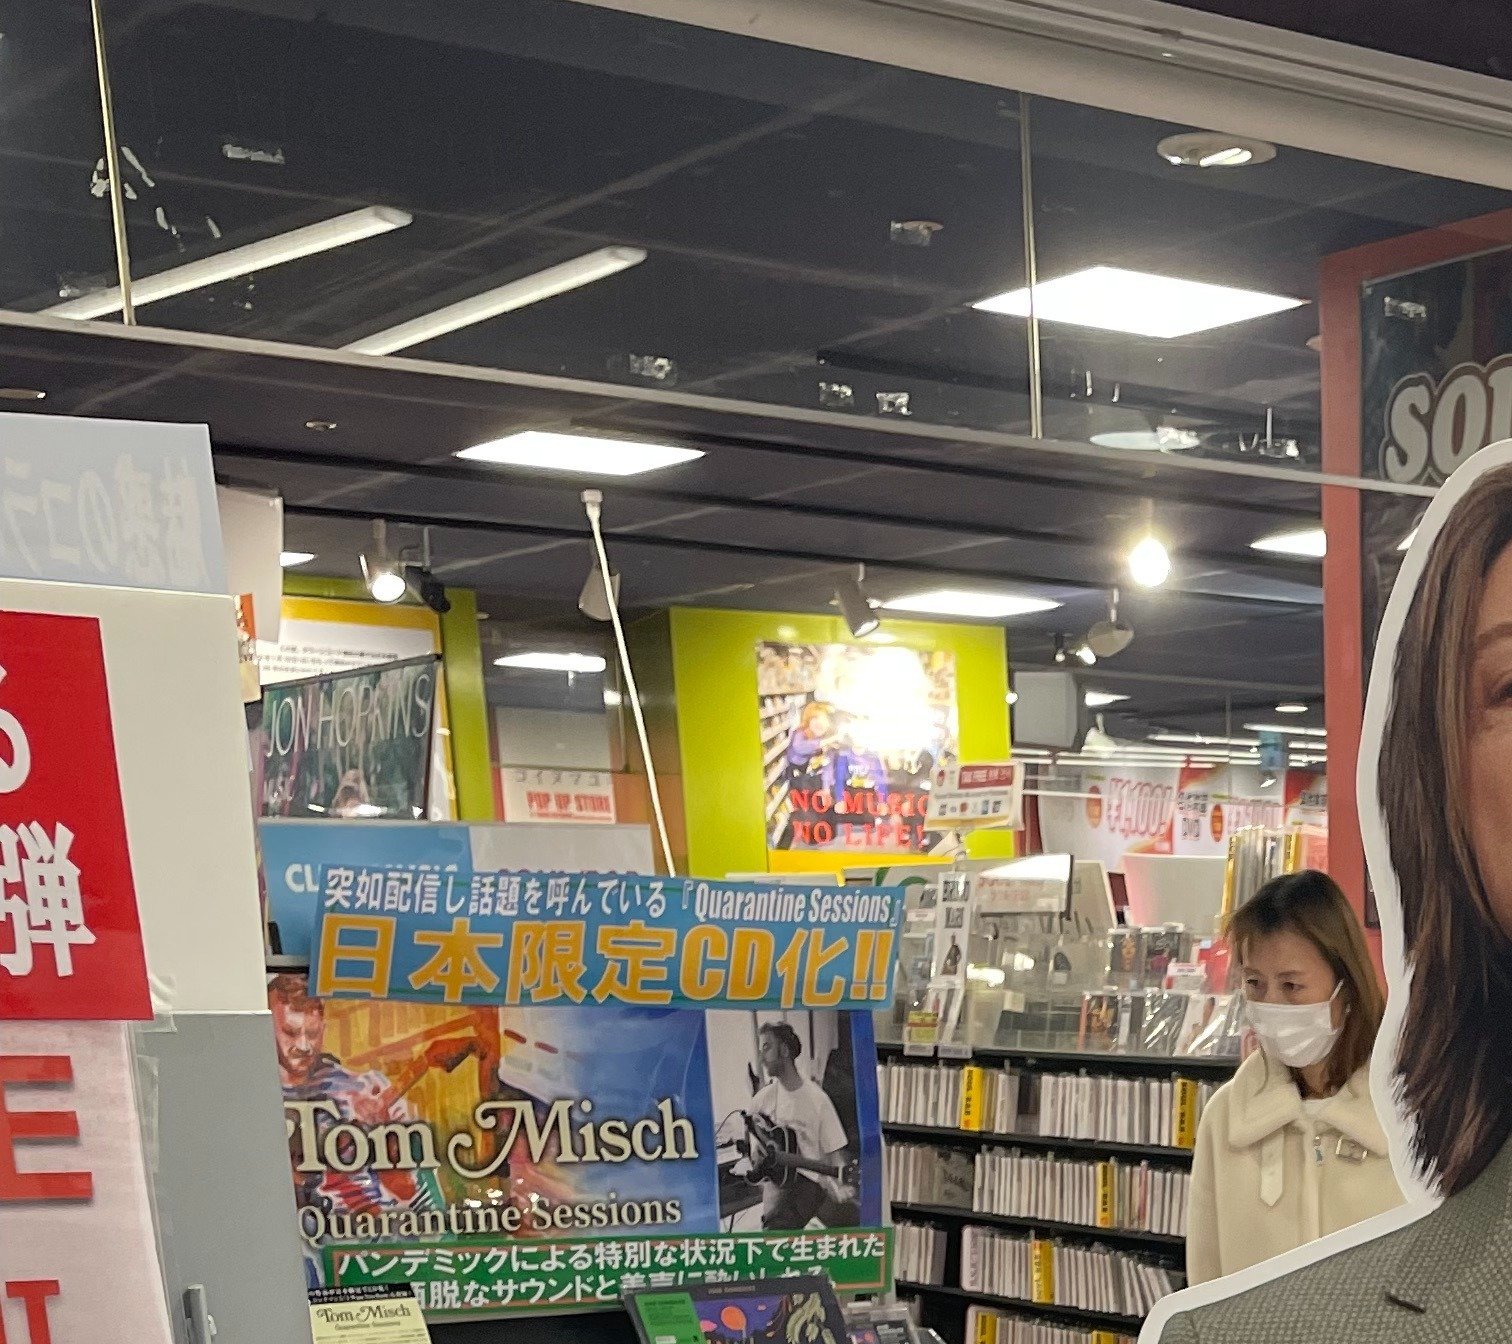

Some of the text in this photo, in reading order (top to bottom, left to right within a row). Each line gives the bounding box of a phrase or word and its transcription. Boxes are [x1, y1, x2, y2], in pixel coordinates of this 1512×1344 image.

[266, 673, 431, 758] JON HOPKINS
[790, 788, 832, 814] NO
[791, 820, 832, 846] NO
[288, 1097, 699, 1179] Tom Misch
[299, 1190, 682, 1248] Quarantine Sessions
